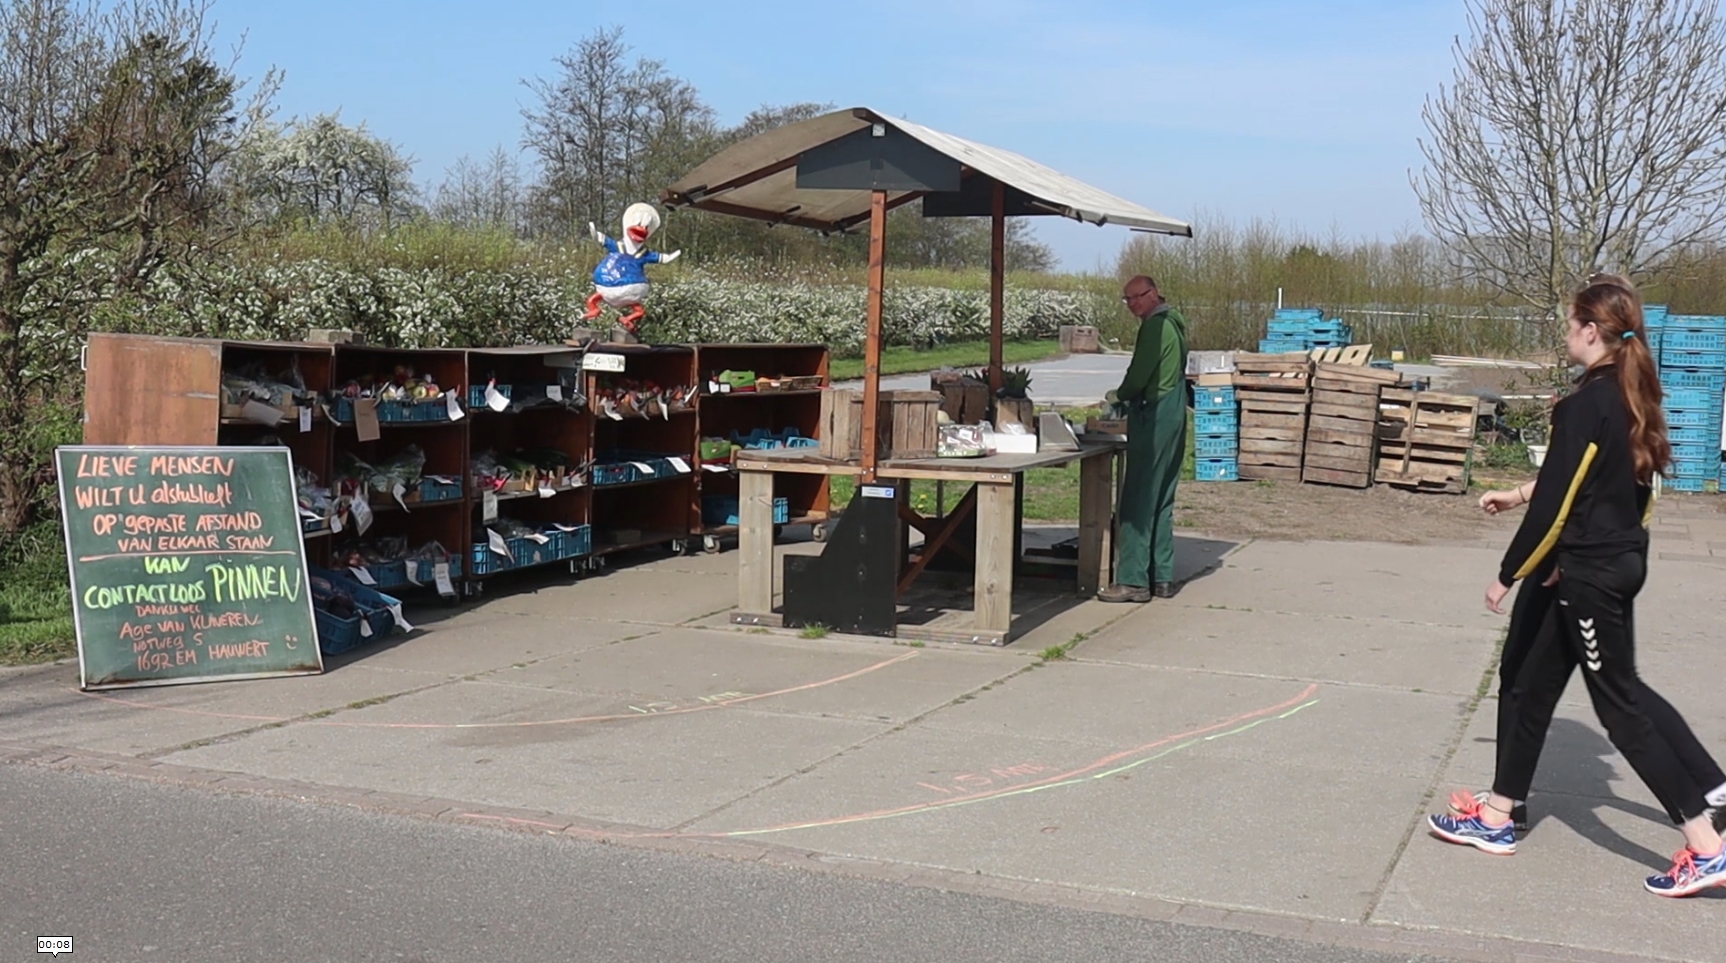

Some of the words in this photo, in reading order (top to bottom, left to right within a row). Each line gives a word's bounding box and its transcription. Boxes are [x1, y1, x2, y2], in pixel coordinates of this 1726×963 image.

[77, 454, 139, 477] LIEVE
[151, 456, 234, 477] MENSEN
[75, 485, 124, 509] WILT
[93, 513, 117, 535] OP
[196, 511, 262, 532] AFSTAND
[117, 537, 152, 552] VAN
[158, 534, 220, 550] ELKAAR
[226, 535, 274, 549] STAAN
[144, 556, 190, 575] KAN
[205, 560, 300, 603] PINNEN
[119, 622, 153, 641] Age
[157, 621, 186, 633] VAN
[137, 650, 175, 672] 1692
[176, 648, 198, 666] EM
[208, 640, 270, 660] HAUWERT
